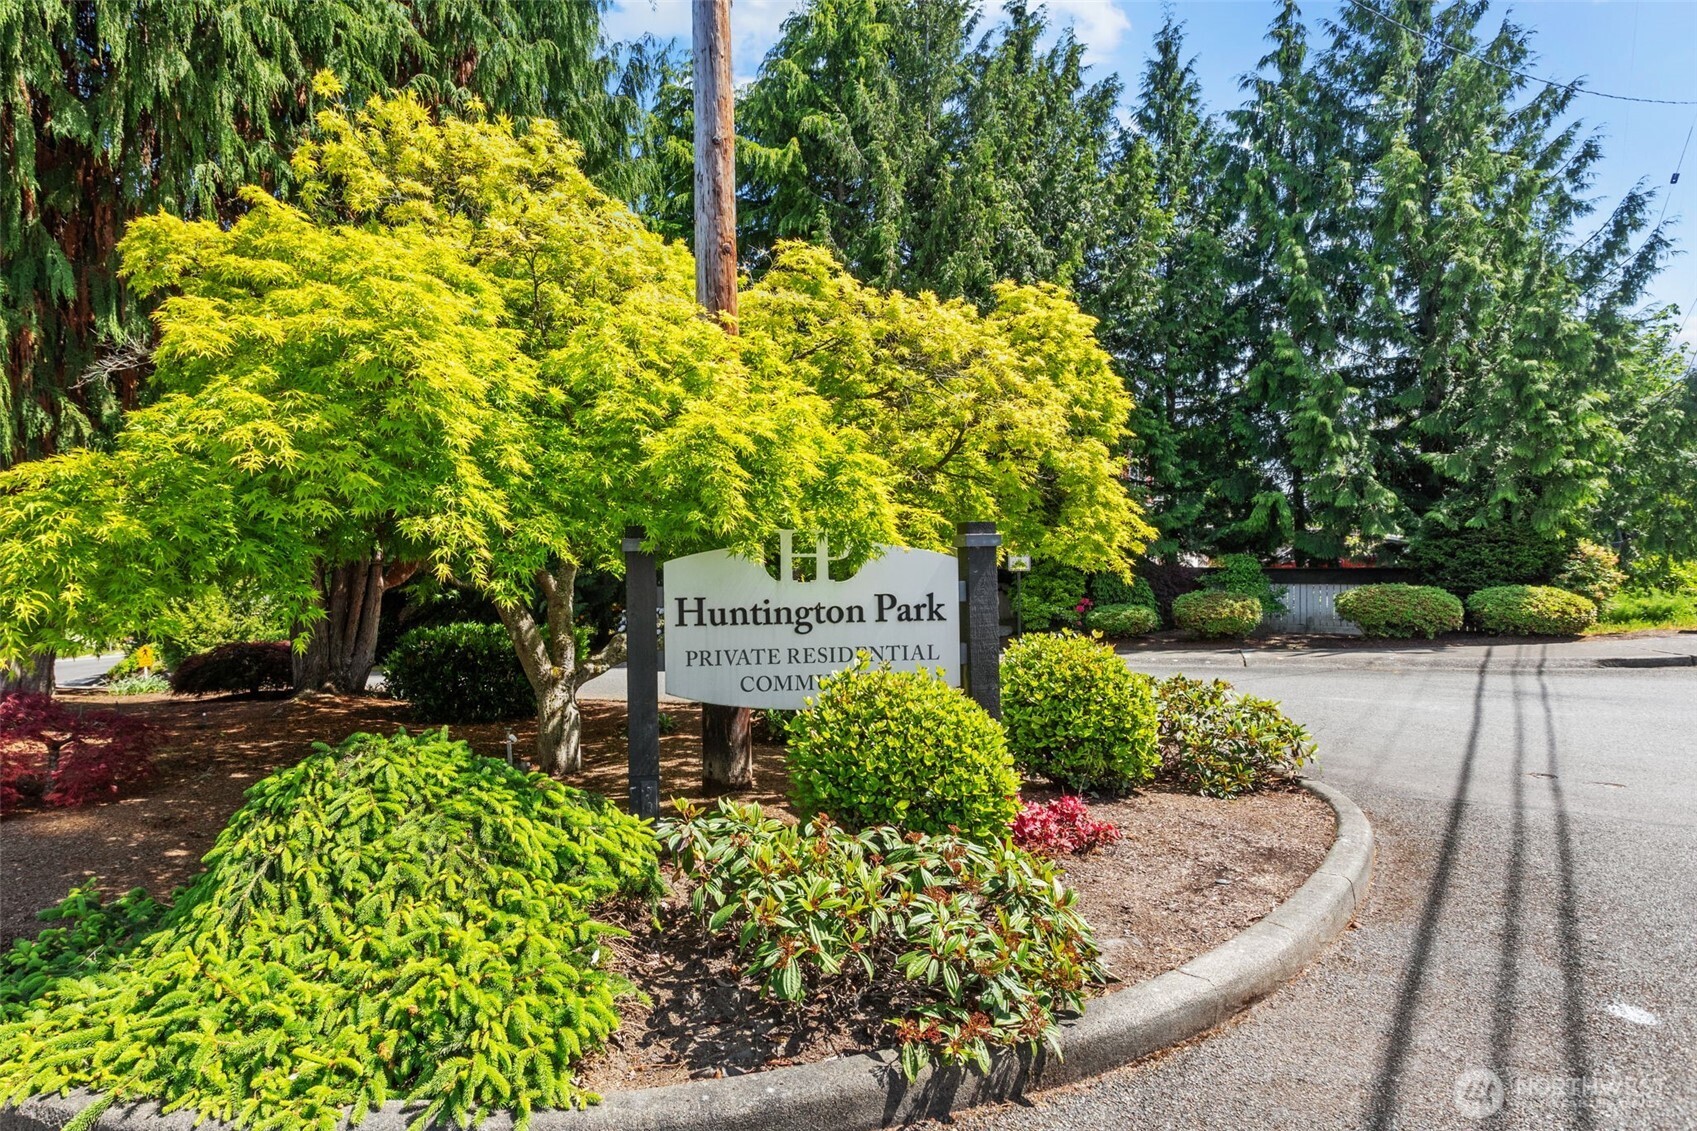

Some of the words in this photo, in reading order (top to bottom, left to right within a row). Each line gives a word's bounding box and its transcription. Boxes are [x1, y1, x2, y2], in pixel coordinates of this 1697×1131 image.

[674, 597, 865, 634] Huntington
[874, 592, 947, 622] Park
[685, 648, 781, 666] PRIVATE
